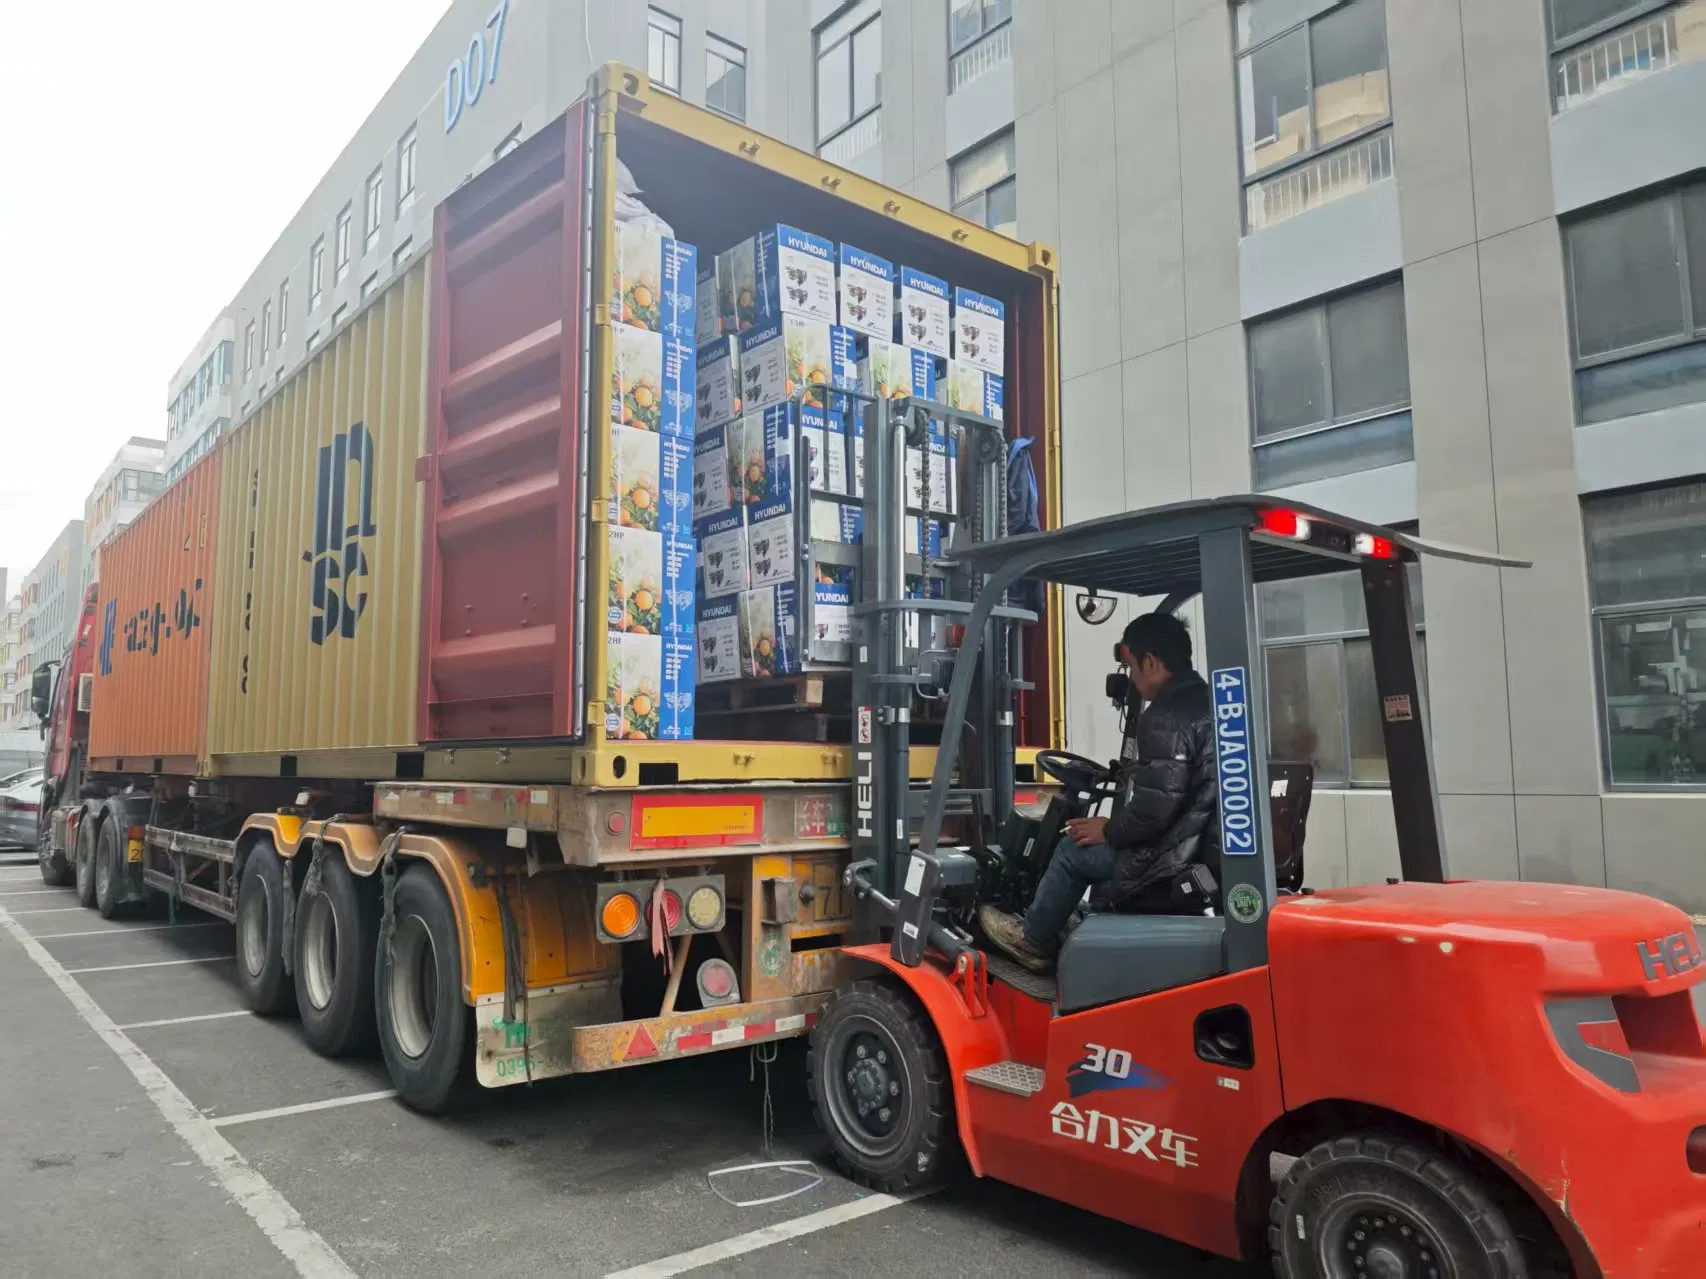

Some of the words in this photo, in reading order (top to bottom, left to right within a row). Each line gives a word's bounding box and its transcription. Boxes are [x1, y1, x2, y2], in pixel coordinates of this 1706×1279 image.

[788, 236, 827, 257] HYUNDAI
[850, 255, 887, 277] HYUNDAI
[910, 277, 944, 296] HYUNDAI
[964, 298, 999, 316] HYUNDAI
[746, 327, 777, 348] HYUNDAI
[801, 414, 838, 430] HYUNAI
[755, 503, 786, 520] HYUNDAI
[708, 517, 738, 533] HYUNDAI
[702, 604, 732, 618] HYUNDAI
[1216, 673, 1251, 848] 4-BJA00002
[857, 752, 872, 838] HELI
[1080, 1042, 1133, 1080] 30
[1050, 1101, 1199, 1168] 合力叉车
